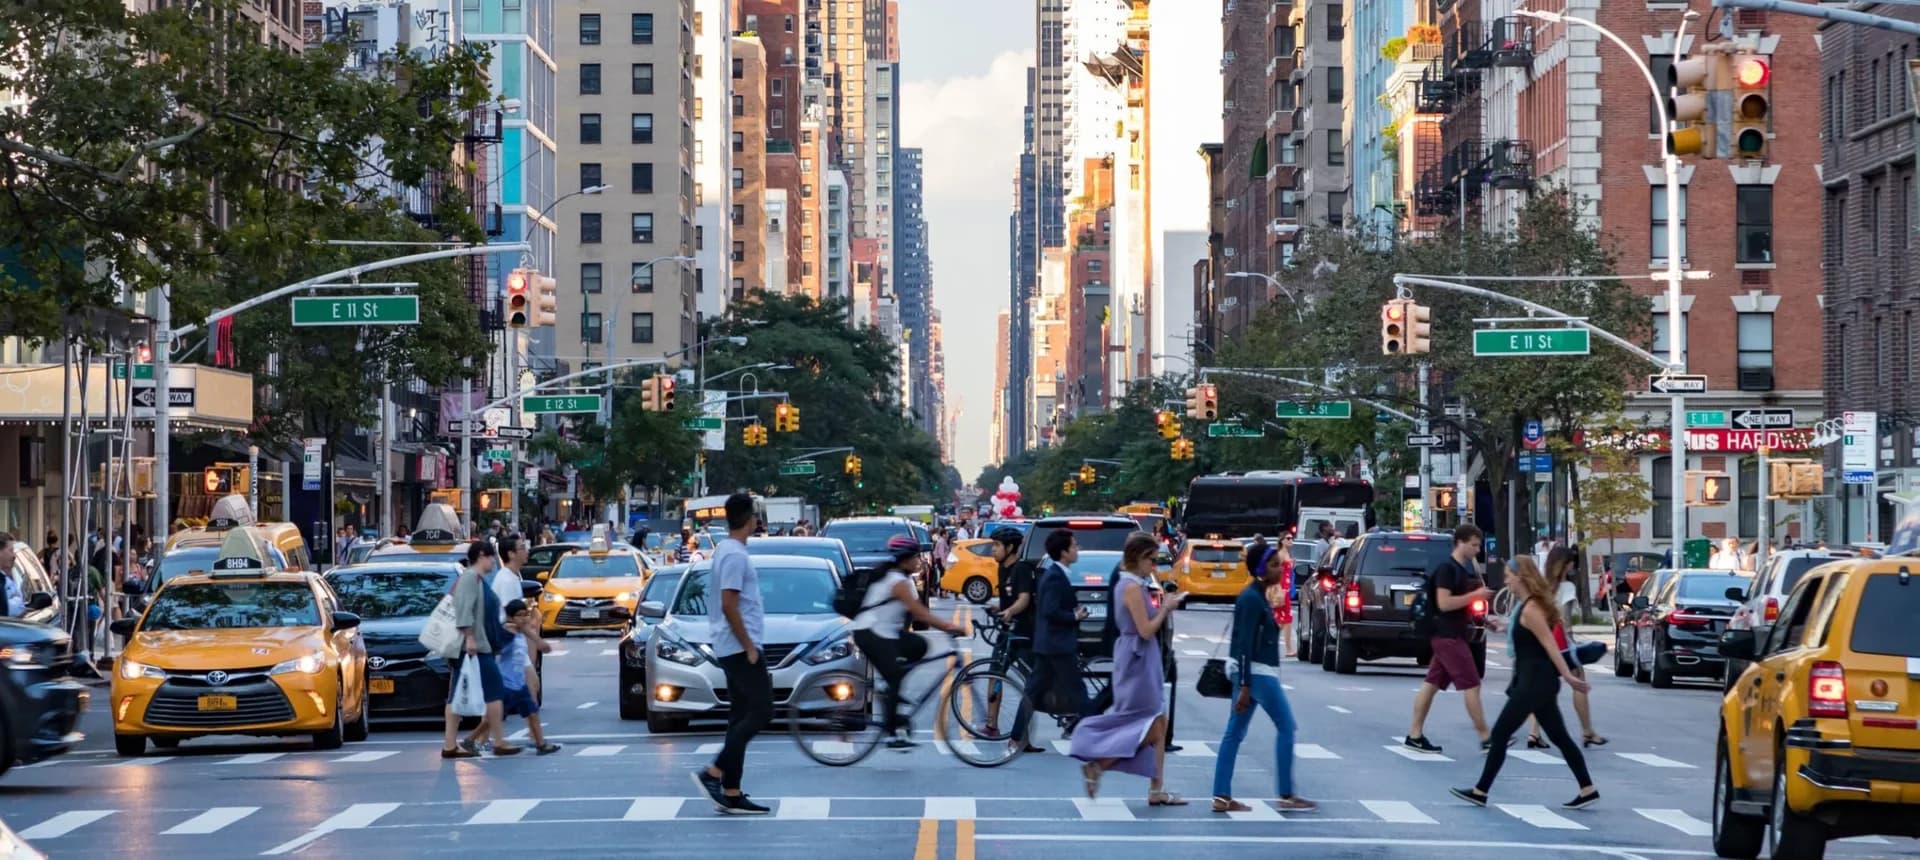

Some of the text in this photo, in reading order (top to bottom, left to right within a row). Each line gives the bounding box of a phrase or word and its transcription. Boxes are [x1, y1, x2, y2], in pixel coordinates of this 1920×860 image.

[332, 302, 378, 318] E 11 St
[1510, 334, 1552, 349] E 11 St
[168, 393, 189, 401] WAY
[545, 398, 577, 410] E 12 St
[1318, 403, 1328, 415] St
[1691, 412, 1698, 425] E
[1701, 412, 1709, 425] 11
[1743, 415, 1787, 426] ONE WAY
[1683, 430, 1719, 450] lus
[425, 530, 440, 540] 7C47
[226, 558, 249, 569] 8H94
